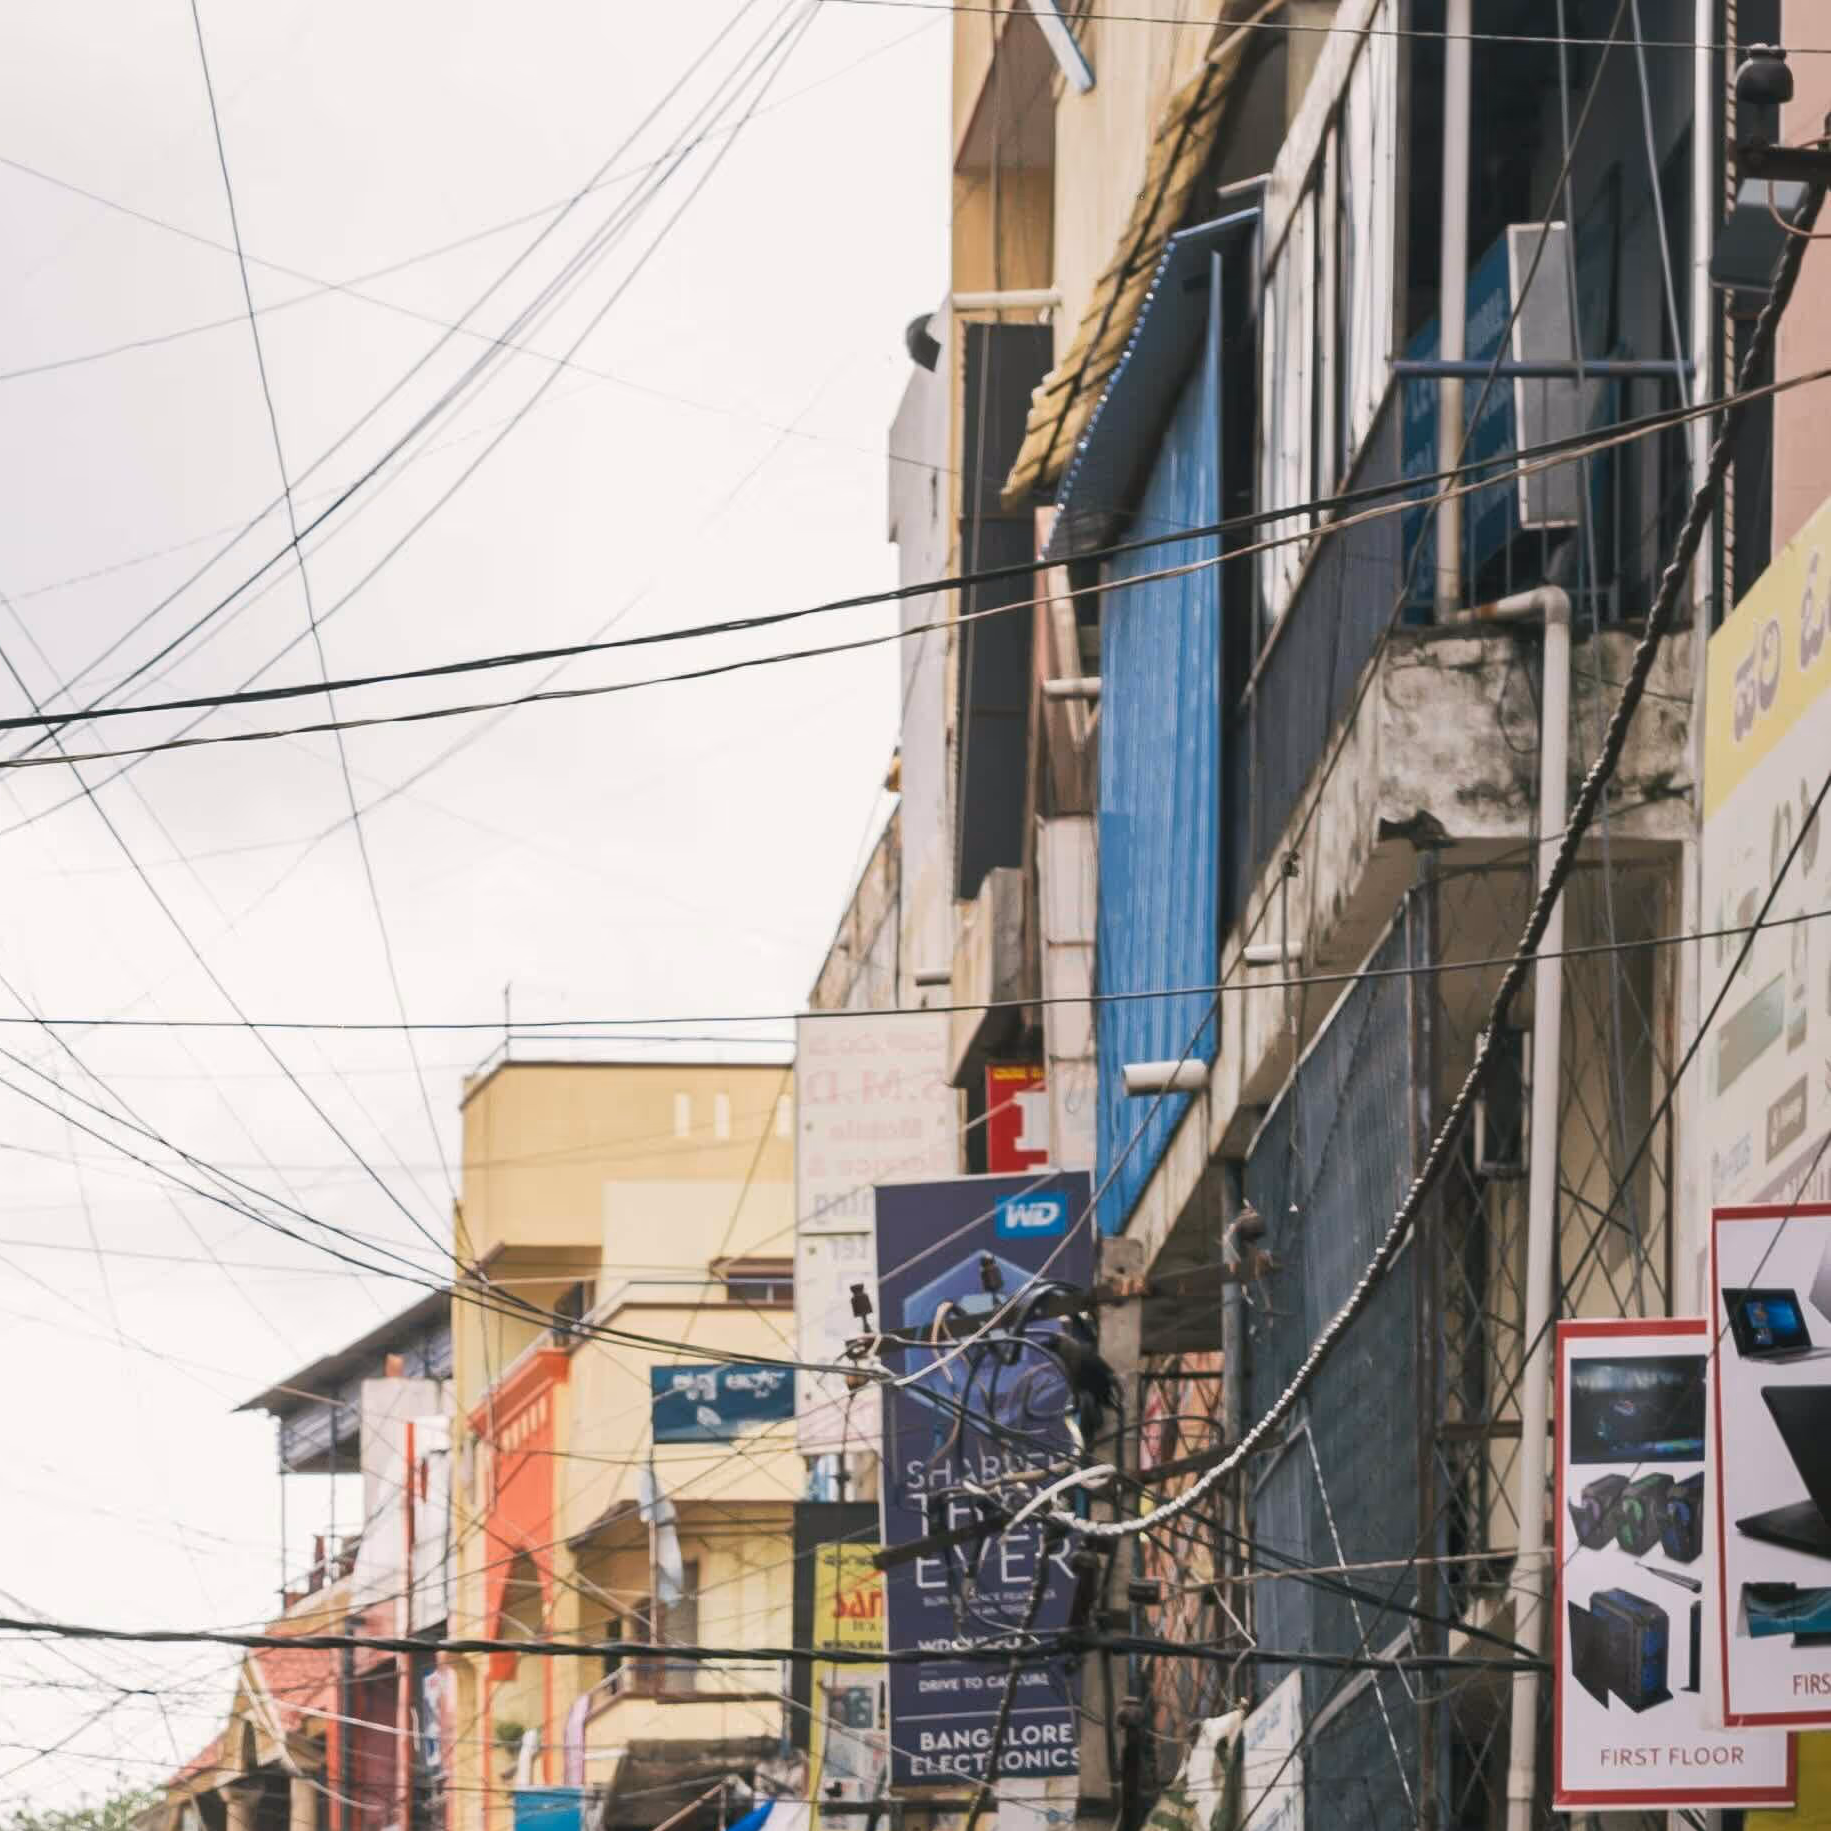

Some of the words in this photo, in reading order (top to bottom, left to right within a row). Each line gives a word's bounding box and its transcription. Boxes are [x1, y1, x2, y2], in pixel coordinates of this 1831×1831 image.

[1005, 1202, 1060, 1228] WD
[1599, 1747, 1661, 1767] FIRST
[1669, 1745, 1745, 1765] FLOOR
